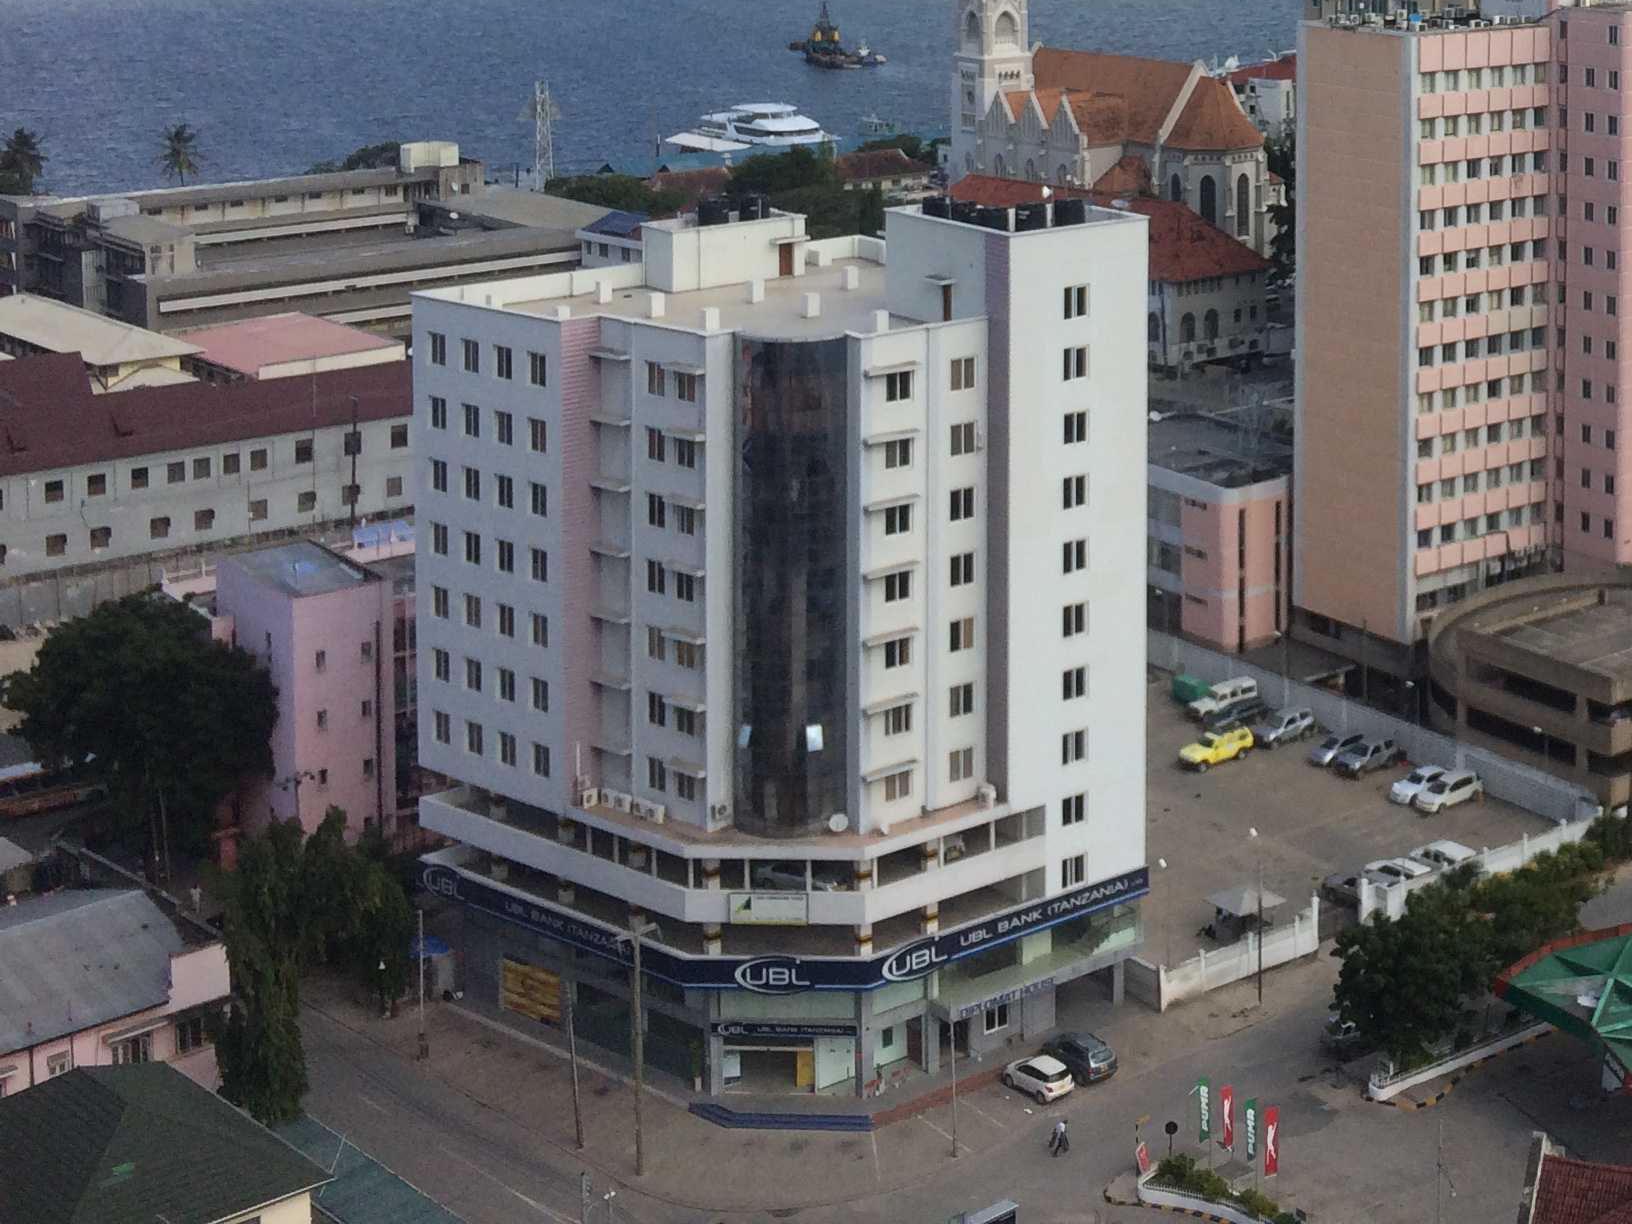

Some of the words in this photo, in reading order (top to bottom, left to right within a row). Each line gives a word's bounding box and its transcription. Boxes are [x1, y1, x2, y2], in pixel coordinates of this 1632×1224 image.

[960, 930, 994, 947] UBL
[997, 911, 1043, 934] BANK
[1047, 879, 1129, 916] (TANZANIA)
[1199, 1085, 1209, 1132] PUMA
[1246, 1108, 1255, 1155] PUMA
